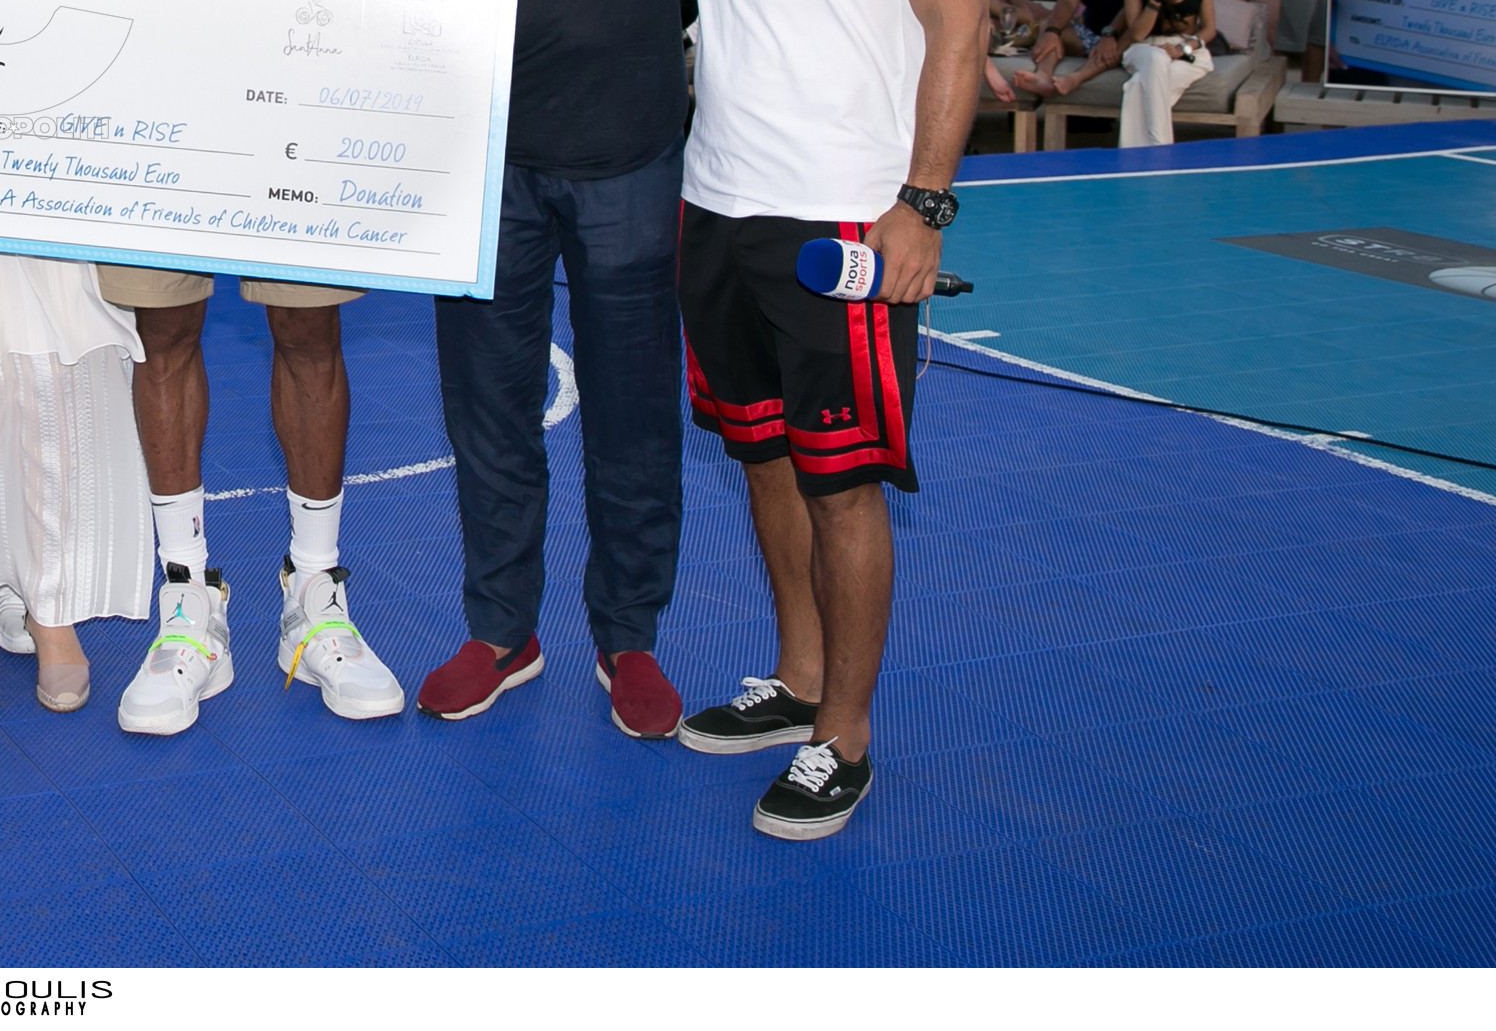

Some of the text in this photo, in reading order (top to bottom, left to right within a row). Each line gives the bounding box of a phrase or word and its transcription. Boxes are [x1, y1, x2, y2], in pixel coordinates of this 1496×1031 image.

[246, 87, 425, 112] DATE: 06/07/2019
[59, 113, 111, 137] GIVE
[114, 126, 126, 139] n
[132, 120, 188, 143] RISE
[284, 137, 407, 163] € 20.000
[2, 150, 58, 181] Twenty
[65, 156, 140, 183] Thousand
[144, 163, 181, 185] Euro
[268, 179, 424, 209] MEMO: Donation
[21, 191, 113, 217] Association
[120, 200, 139, 219] of
[141, 201, 201, 226] Friends
[208, 209, 228, 228] of
[229, 210, 299, 235] Children
[305, 218, 340, 239] with
[347, 221, 408, 246] Cancer
[844, 250, 859, 290] nova
[855, 250, 868, 292] sports
